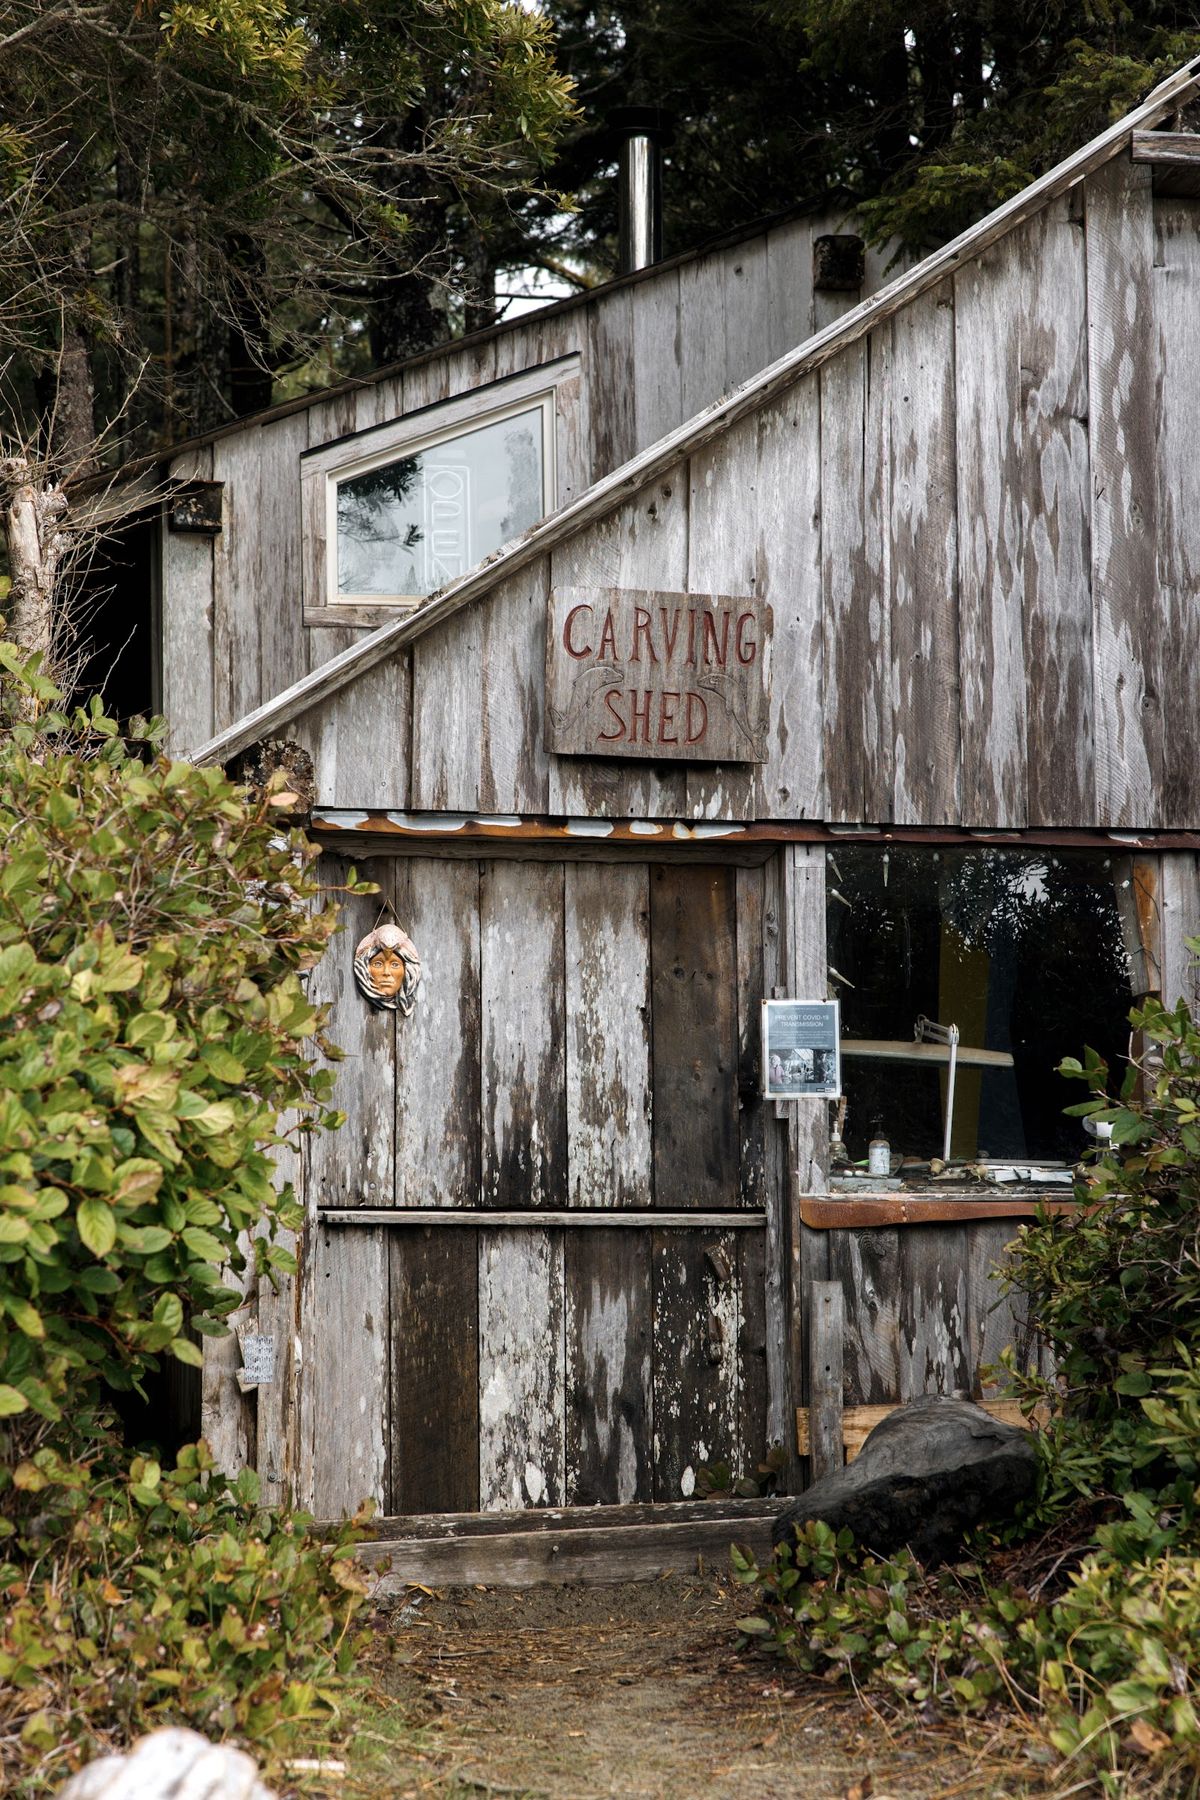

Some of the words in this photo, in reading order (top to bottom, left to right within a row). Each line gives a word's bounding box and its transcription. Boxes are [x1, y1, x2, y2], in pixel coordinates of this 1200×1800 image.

[430, 470, 464, 579] OPEN
[562, 604, 757, 667] CARVING
[597, 689, 709, 746] SHED
